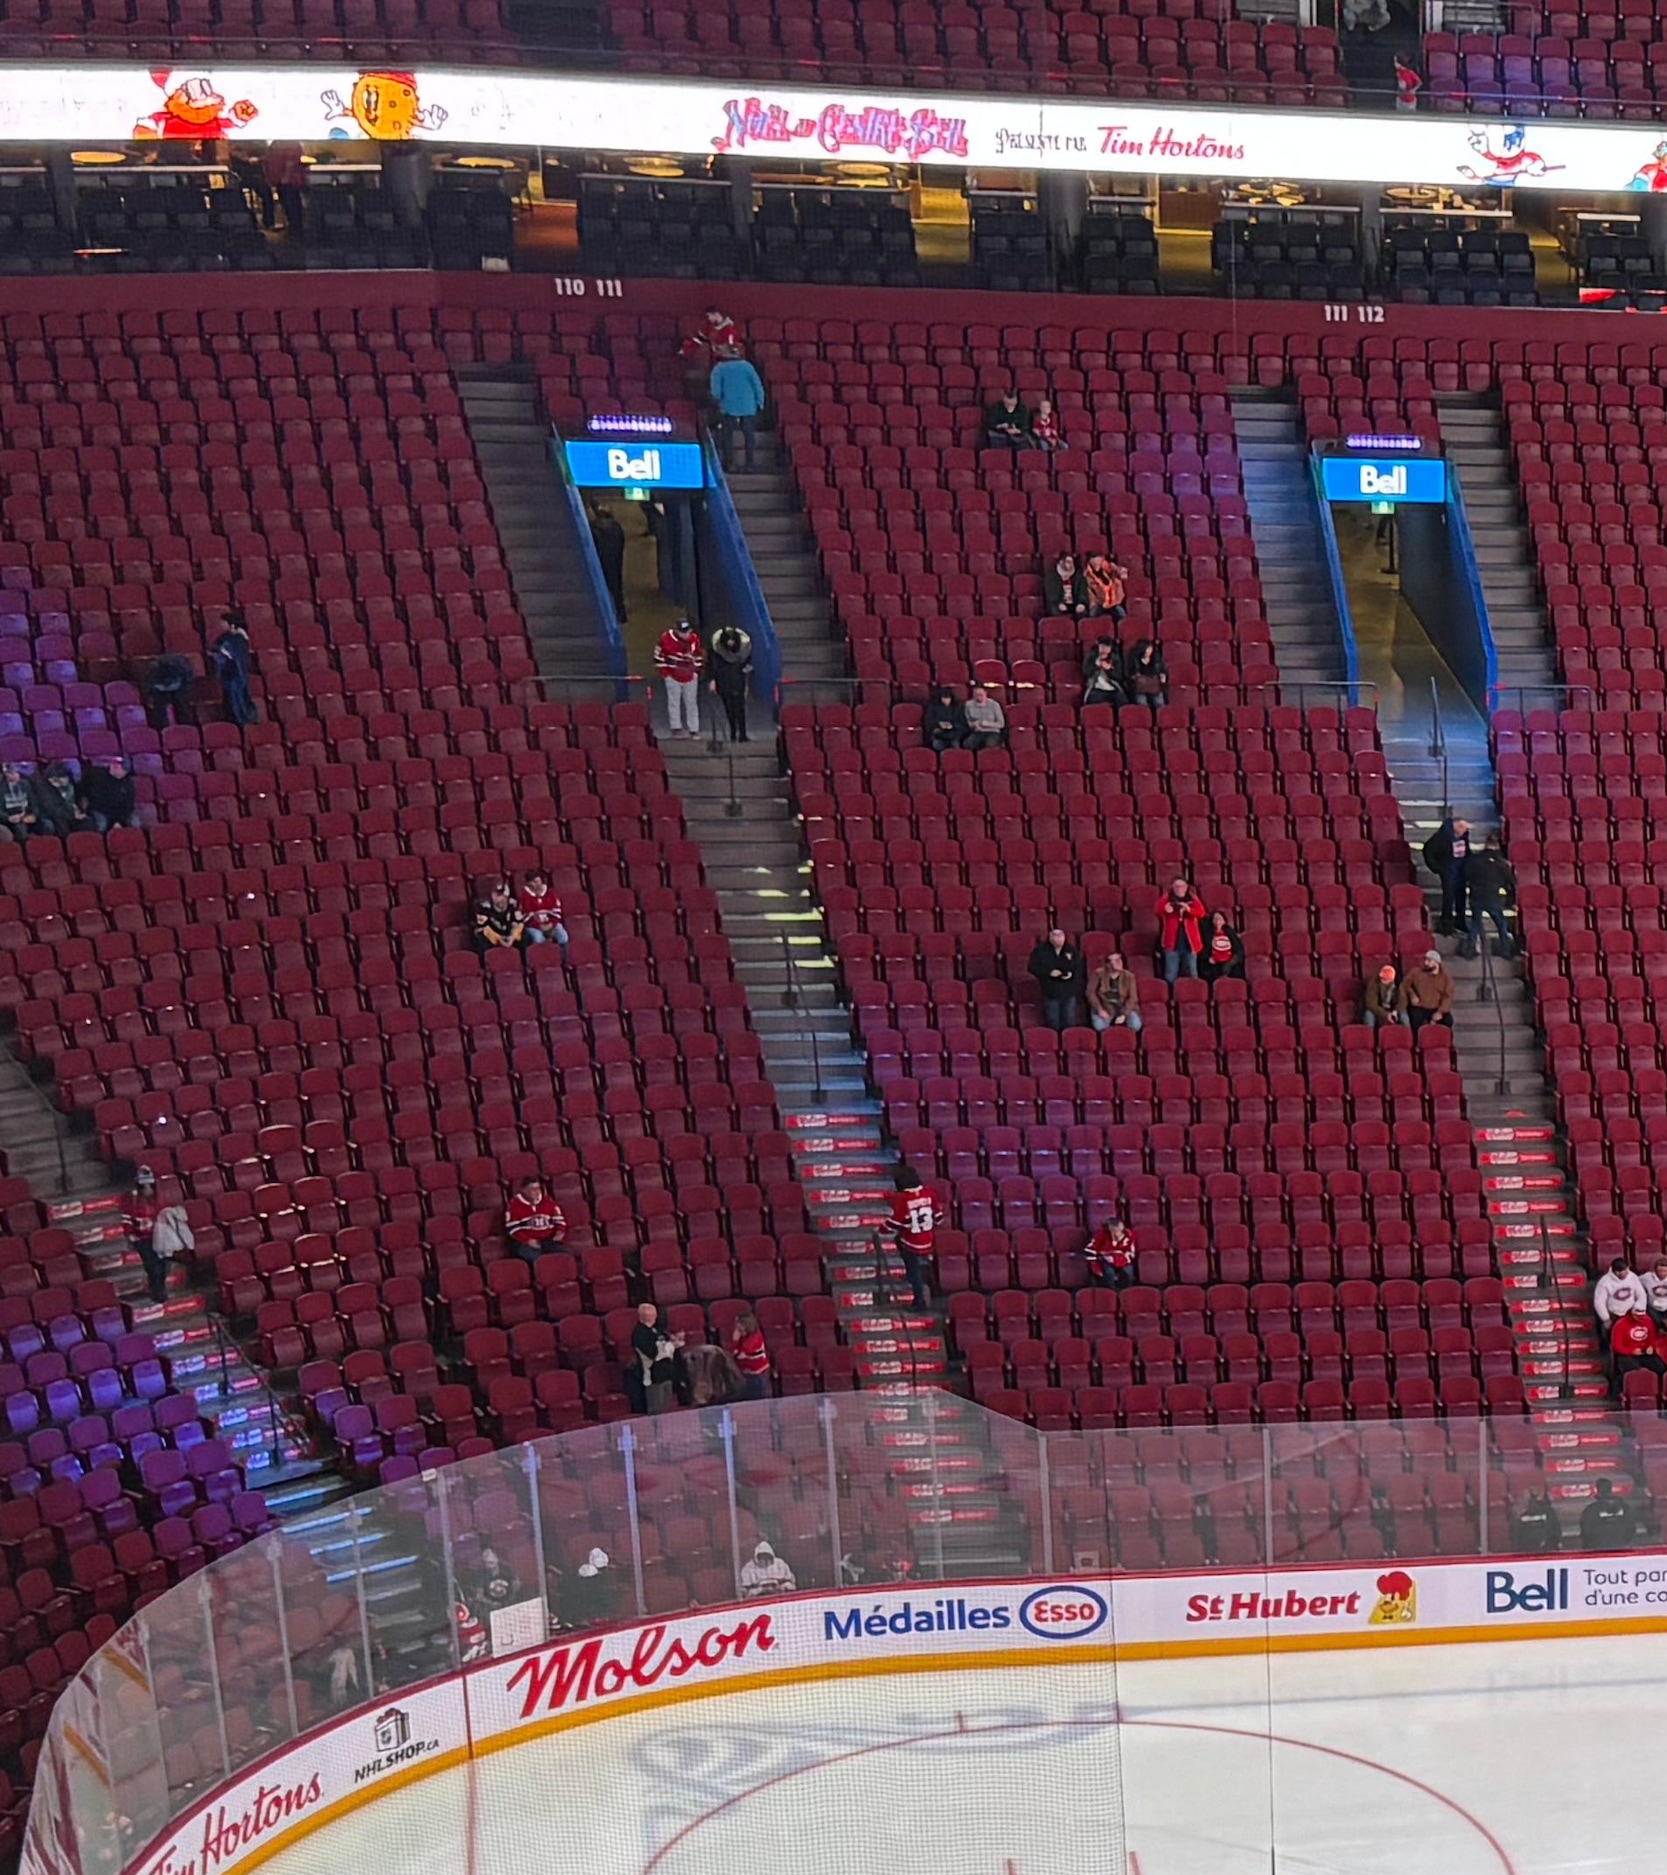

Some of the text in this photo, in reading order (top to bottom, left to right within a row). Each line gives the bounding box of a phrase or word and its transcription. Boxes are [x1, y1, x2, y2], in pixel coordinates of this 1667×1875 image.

[1097, 126, 1143, 156] Tim
[1149, 126, 1245, 159] Hortons
[554, 277, 623, 297] 110 111
[1324, 304, 1384, 323] 111 112
[607, 448, 661, 480] Bell
[1359, 465, 1407, 496] Bell
[1485, 1568, 1569, 1613] Bell
[1583, 1569, 1628, 1585] Tout
[1227, 1590, 1360, 1620] Hubert
[1585, 1586, 1639, 1607] d'une
[823, 1598, 1096, 1641] Médailles Esso
[507, 1614, 776, 1718] Molson
[354, 1739, 440, 1783] NHLSHOP.CA
[199, 1772, 323, 1875] Hortons
